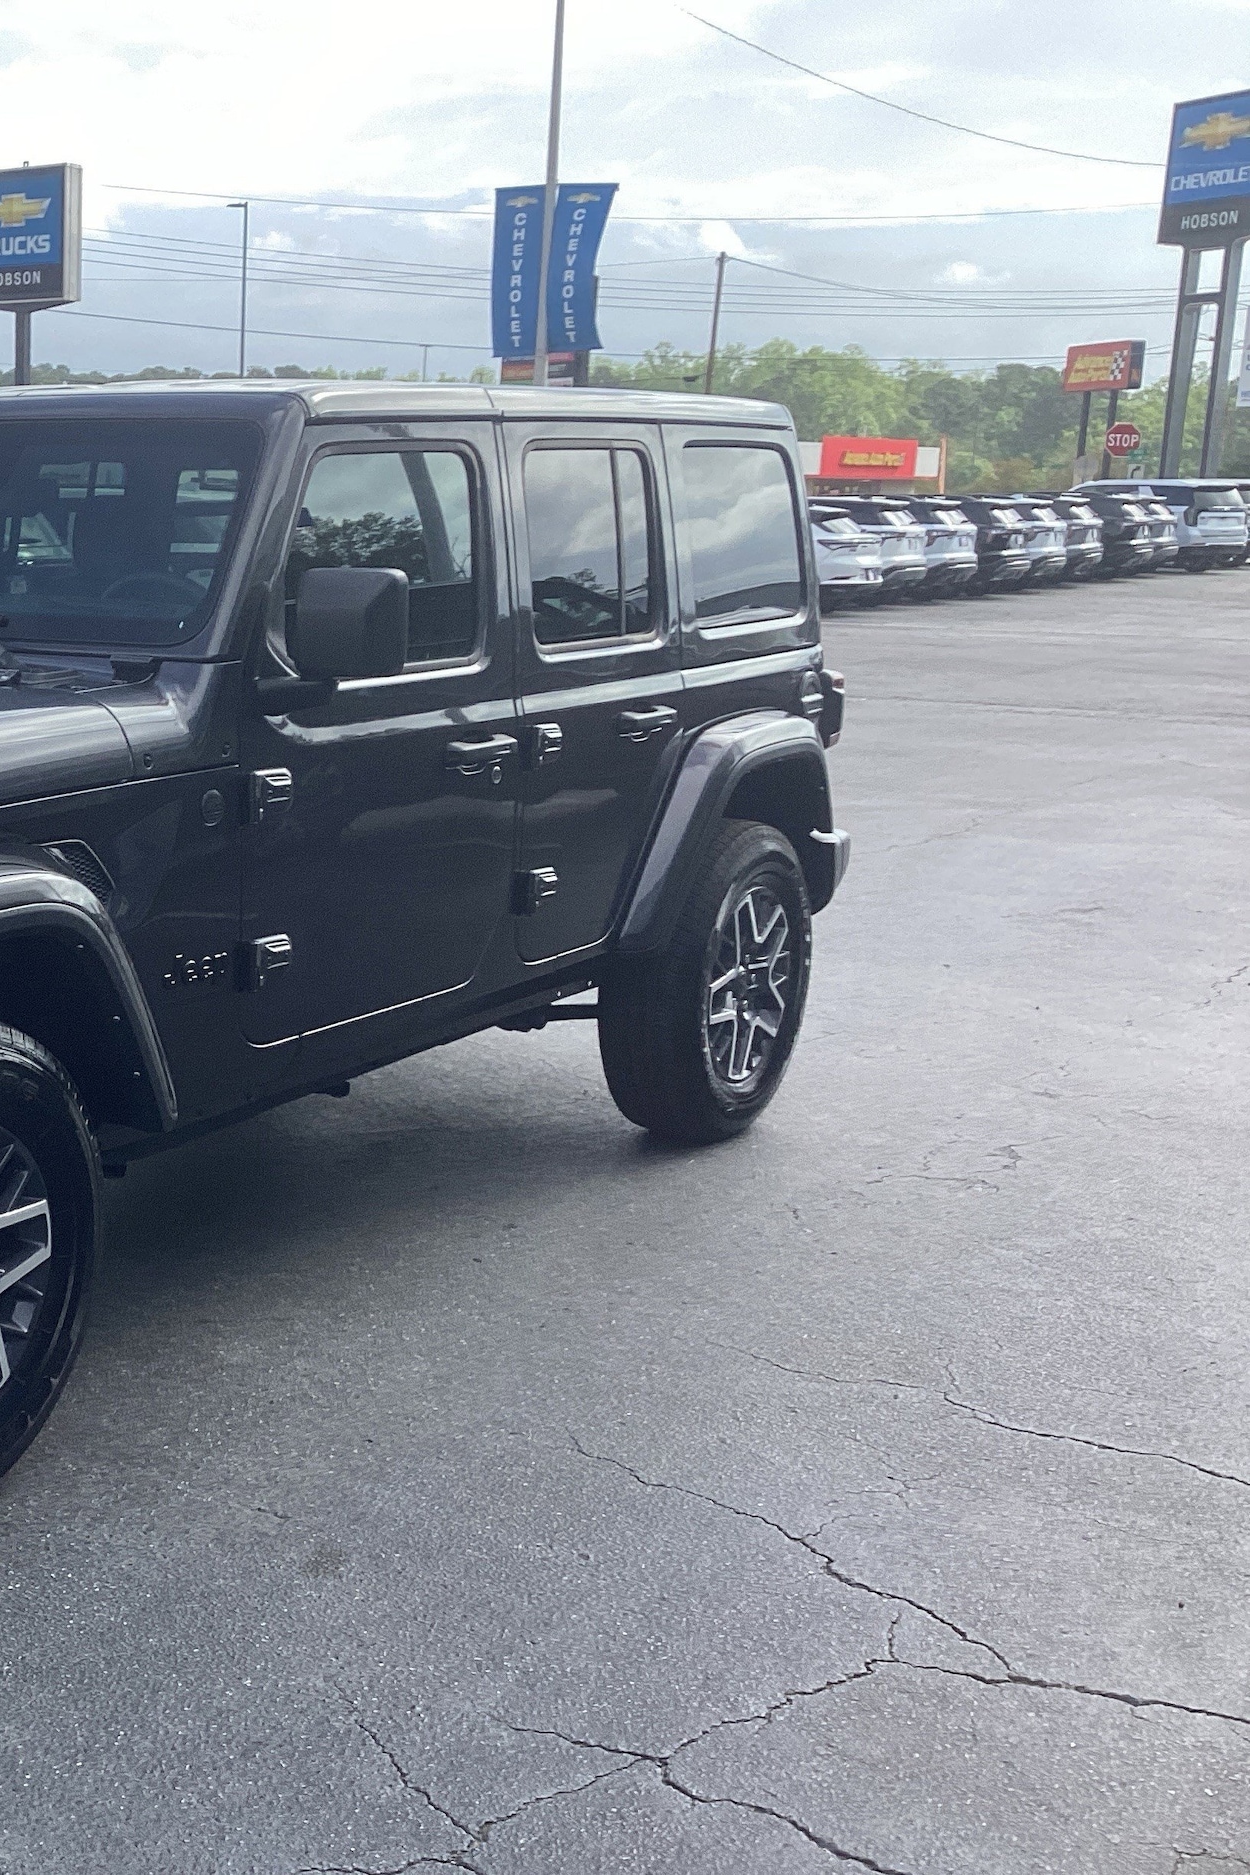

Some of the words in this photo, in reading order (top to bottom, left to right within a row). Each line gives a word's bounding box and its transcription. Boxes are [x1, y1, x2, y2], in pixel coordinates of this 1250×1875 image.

[1171, 165, 1250, 192] CHEVROLE
[1181, 210, 1239, 230] HOBSON
[509, 213, 528, 347] CHEVROLET
[562, 208, 587, 343] CHEVROLET
[1107, 433, 1140, 447] STOP
